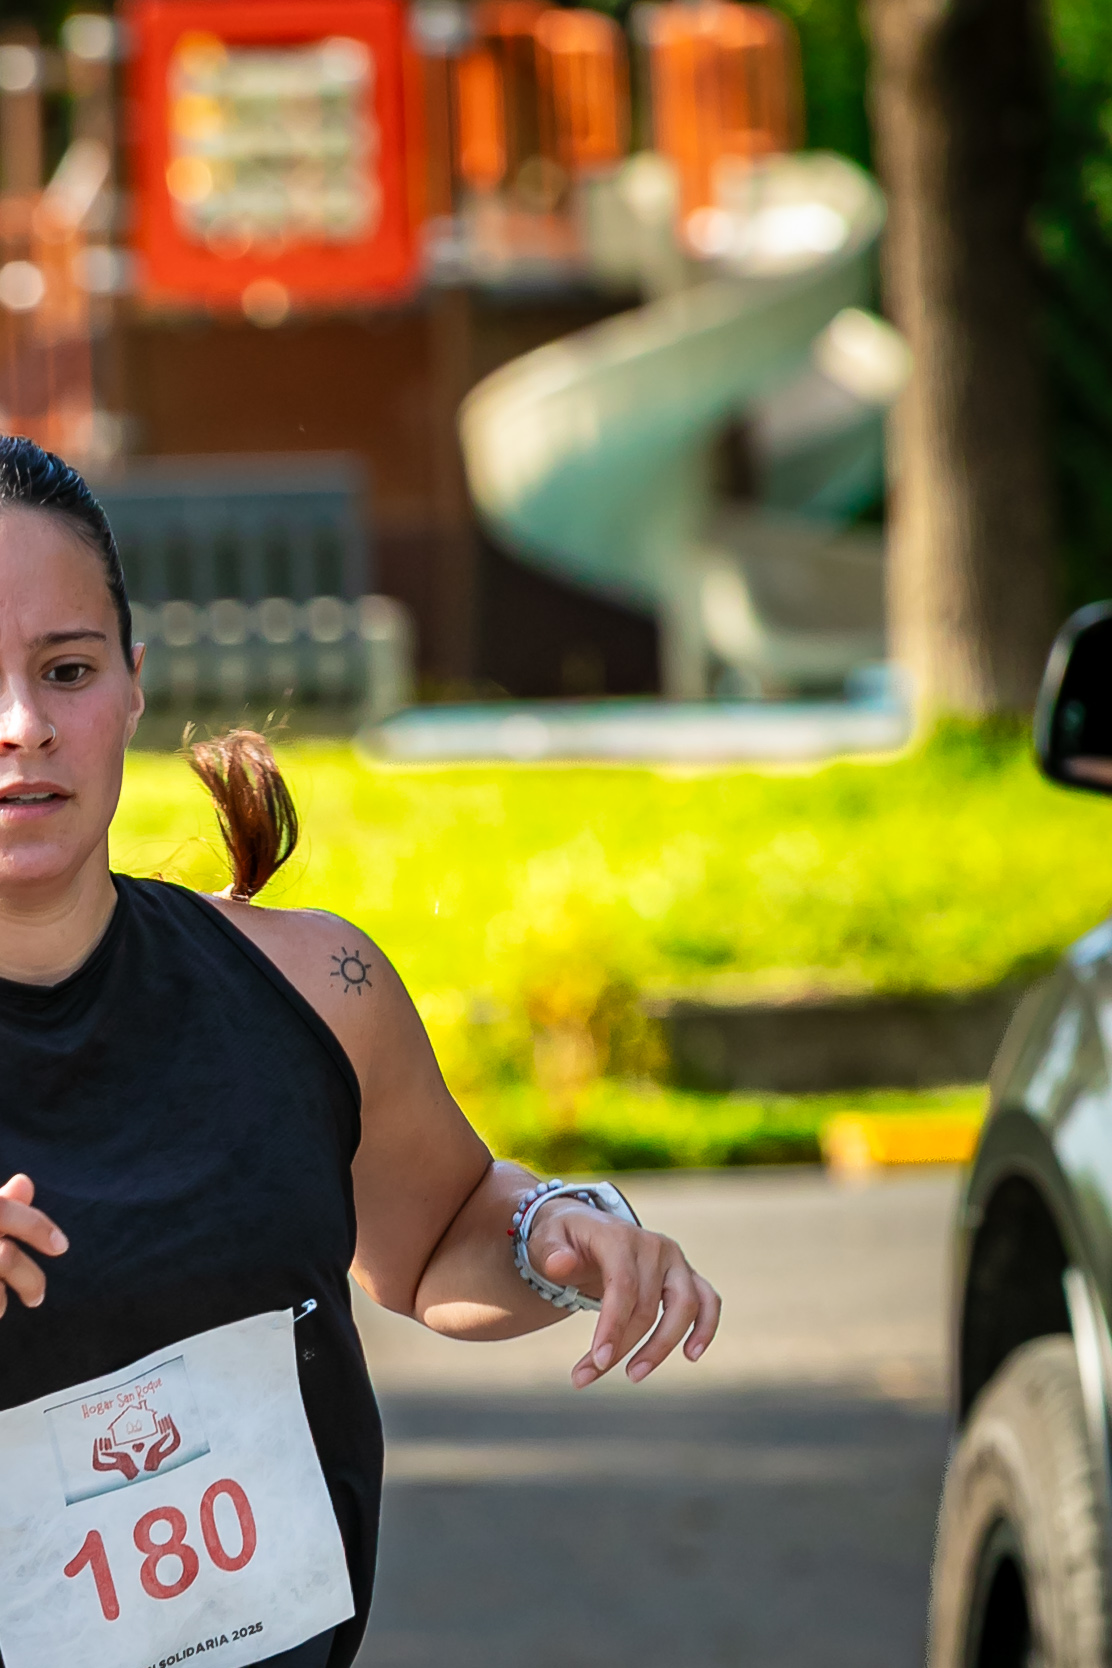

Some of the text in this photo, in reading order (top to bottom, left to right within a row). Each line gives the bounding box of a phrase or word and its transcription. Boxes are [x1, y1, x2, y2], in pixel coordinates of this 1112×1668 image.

[81, 1377, 163, 1420] Hogar San Roque
[63, 1478, 257, 1621] 180
[231, 1621, 264, 1642] 2025
